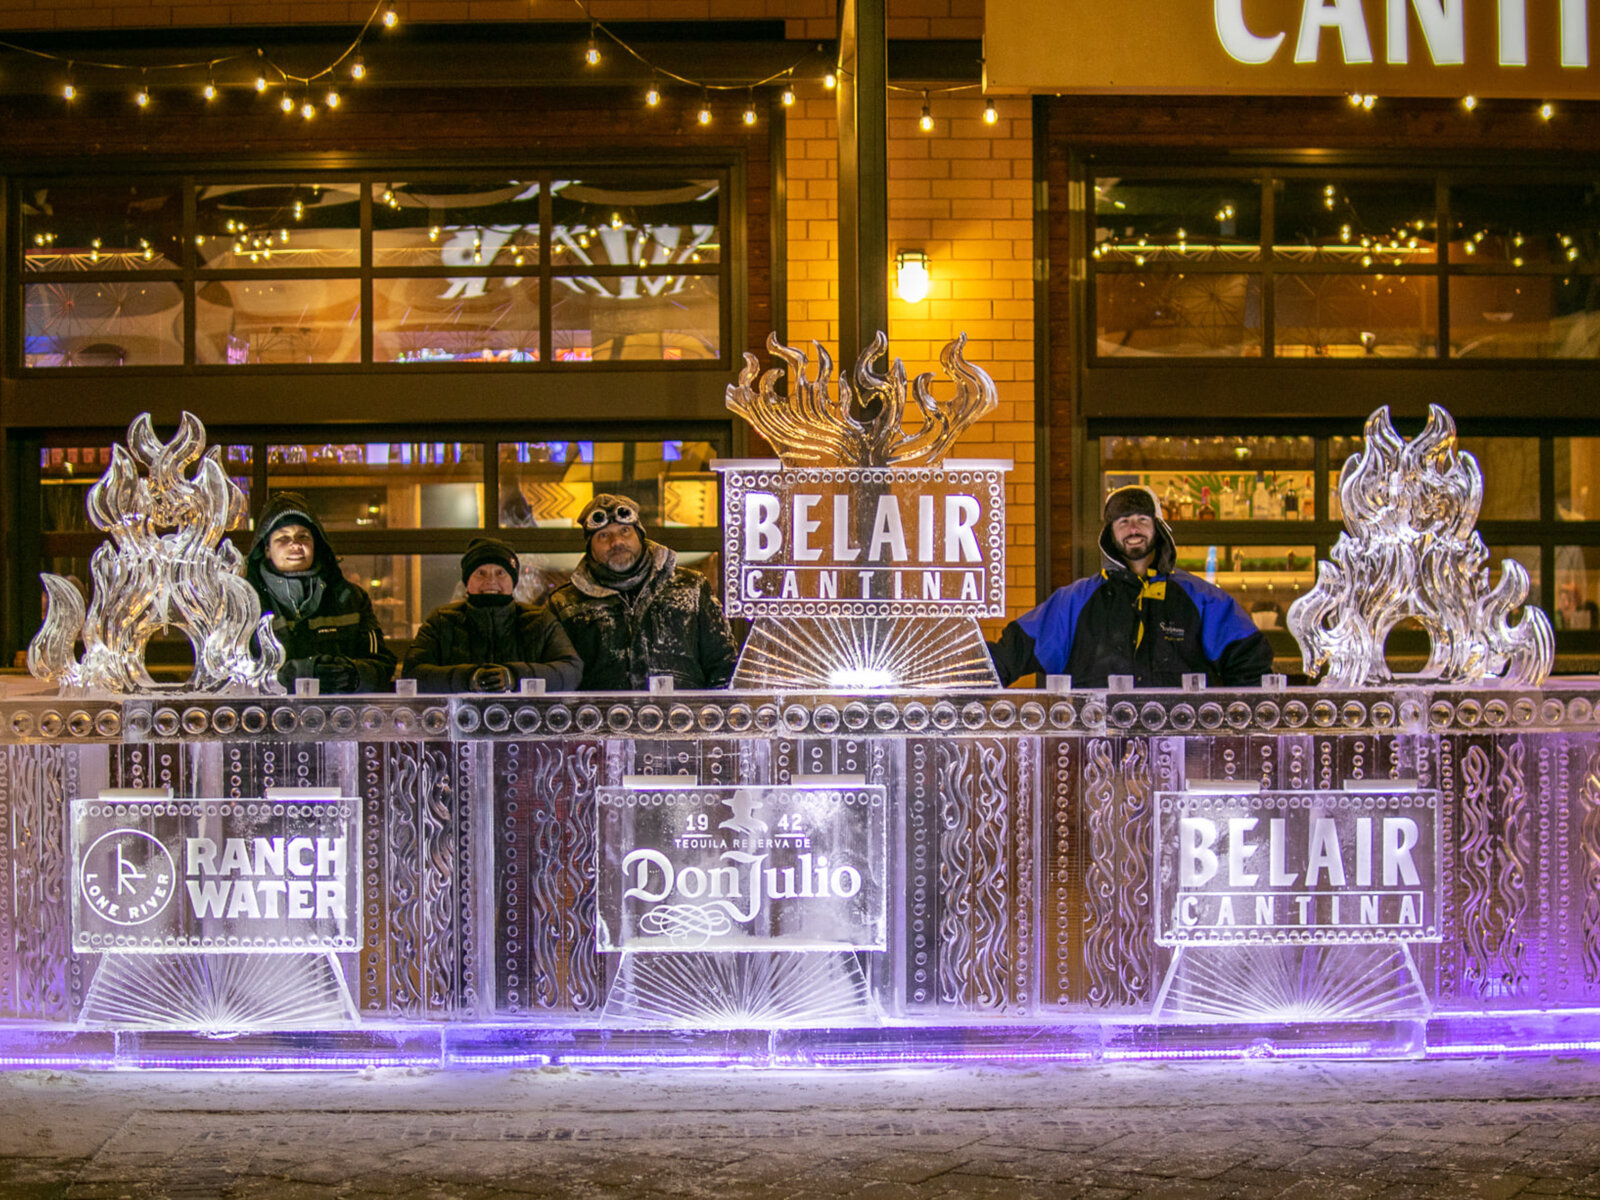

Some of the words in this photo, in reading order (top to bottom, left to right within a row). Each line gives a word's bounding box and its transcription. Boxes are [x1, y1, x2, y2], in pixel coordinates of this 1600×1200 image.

[745, 492, 983, 562] BELAIR
[746, 569, 979, 600] CANTINA
[686, 813, 709, 831] 19
[777, 813, 803, 831] 42
[186, 837, 347, 876] RANCH
[674, 839, 727, 849] TEQUILA
[795, 838, 811, 849] DE
[1180, 817, 1421, 887] BELAIR
[86, 873, 120, 917] LONE
[128, 873, 169, 919] RIVER
[185, 880, 347, 919] WATER
[621, 848, 743, 902] Don
[719, 850, 862, 923] Julio
[1181, 896, 1417, 925] CANTINA
